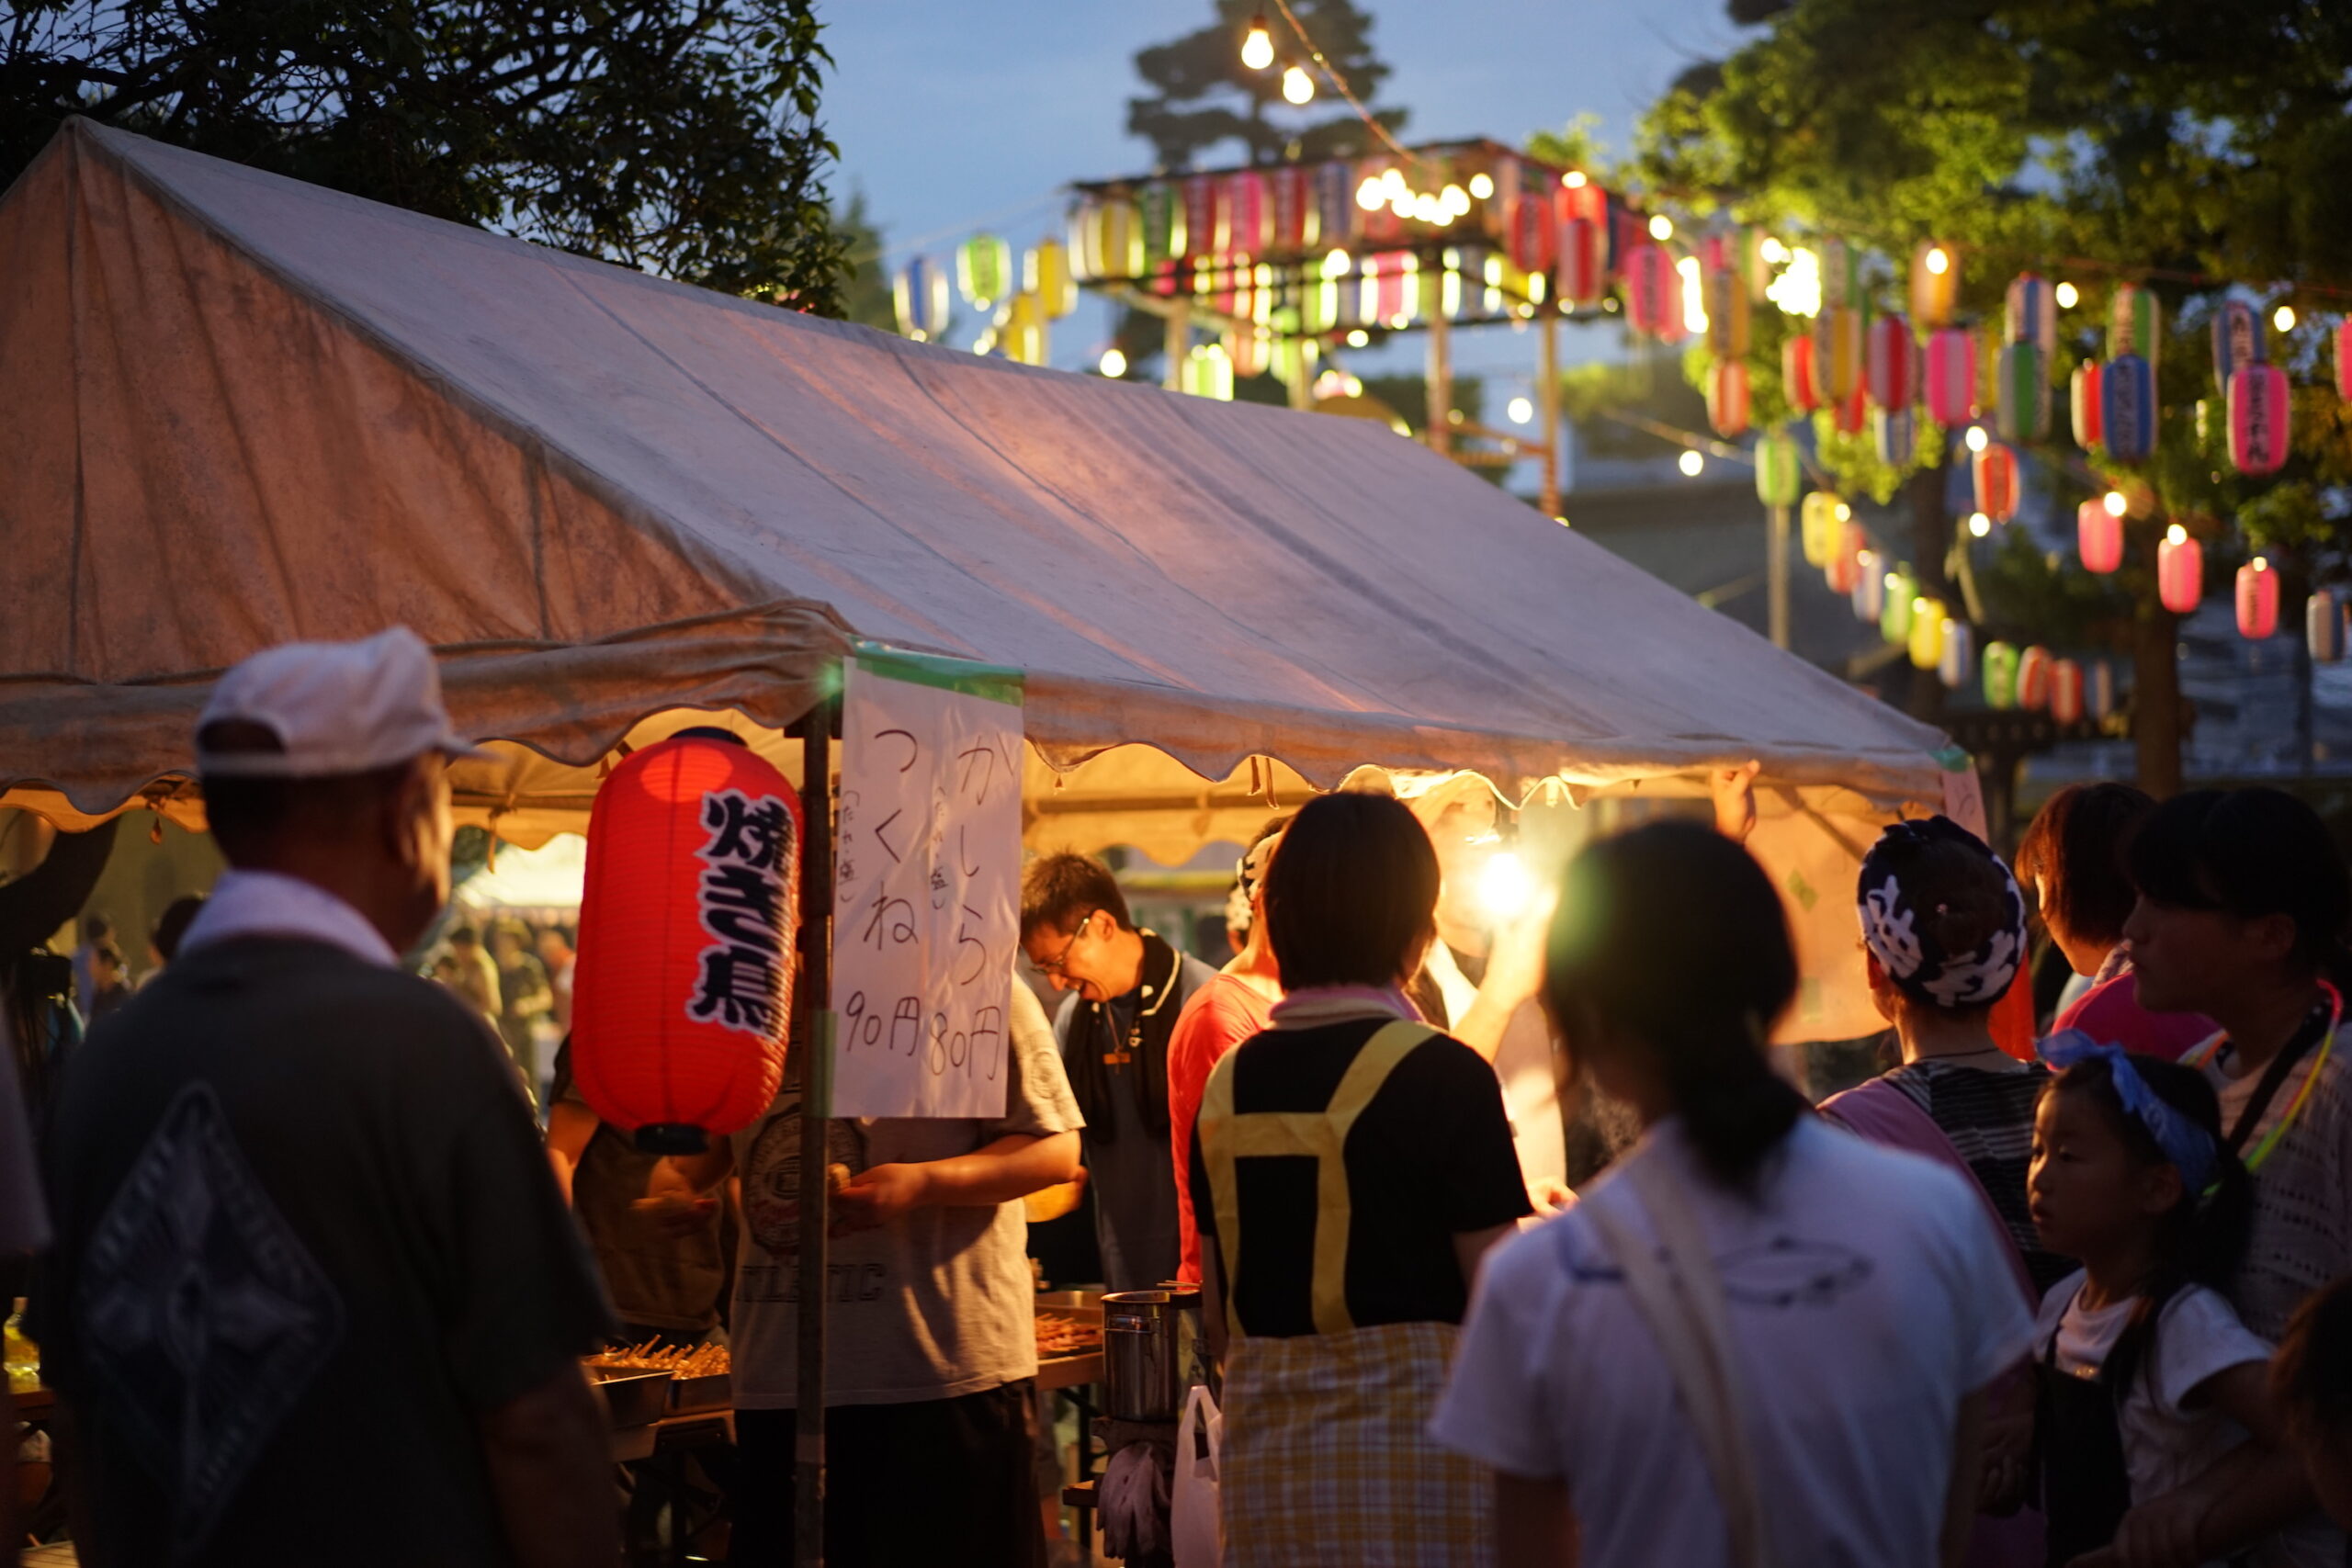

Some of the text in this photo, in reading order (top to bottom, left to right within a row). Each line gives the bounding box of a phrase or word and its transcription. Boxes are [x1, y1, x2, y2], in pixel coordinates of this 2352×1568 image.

[687, 790, 797, 1042] 焼き鳥
[862, 729, 919, 952] つくね
[957, 732, 1014, 987] かしら
[844, 989, 920, 1058] 90円
[929, 1004, 1002, 1082] 80円
